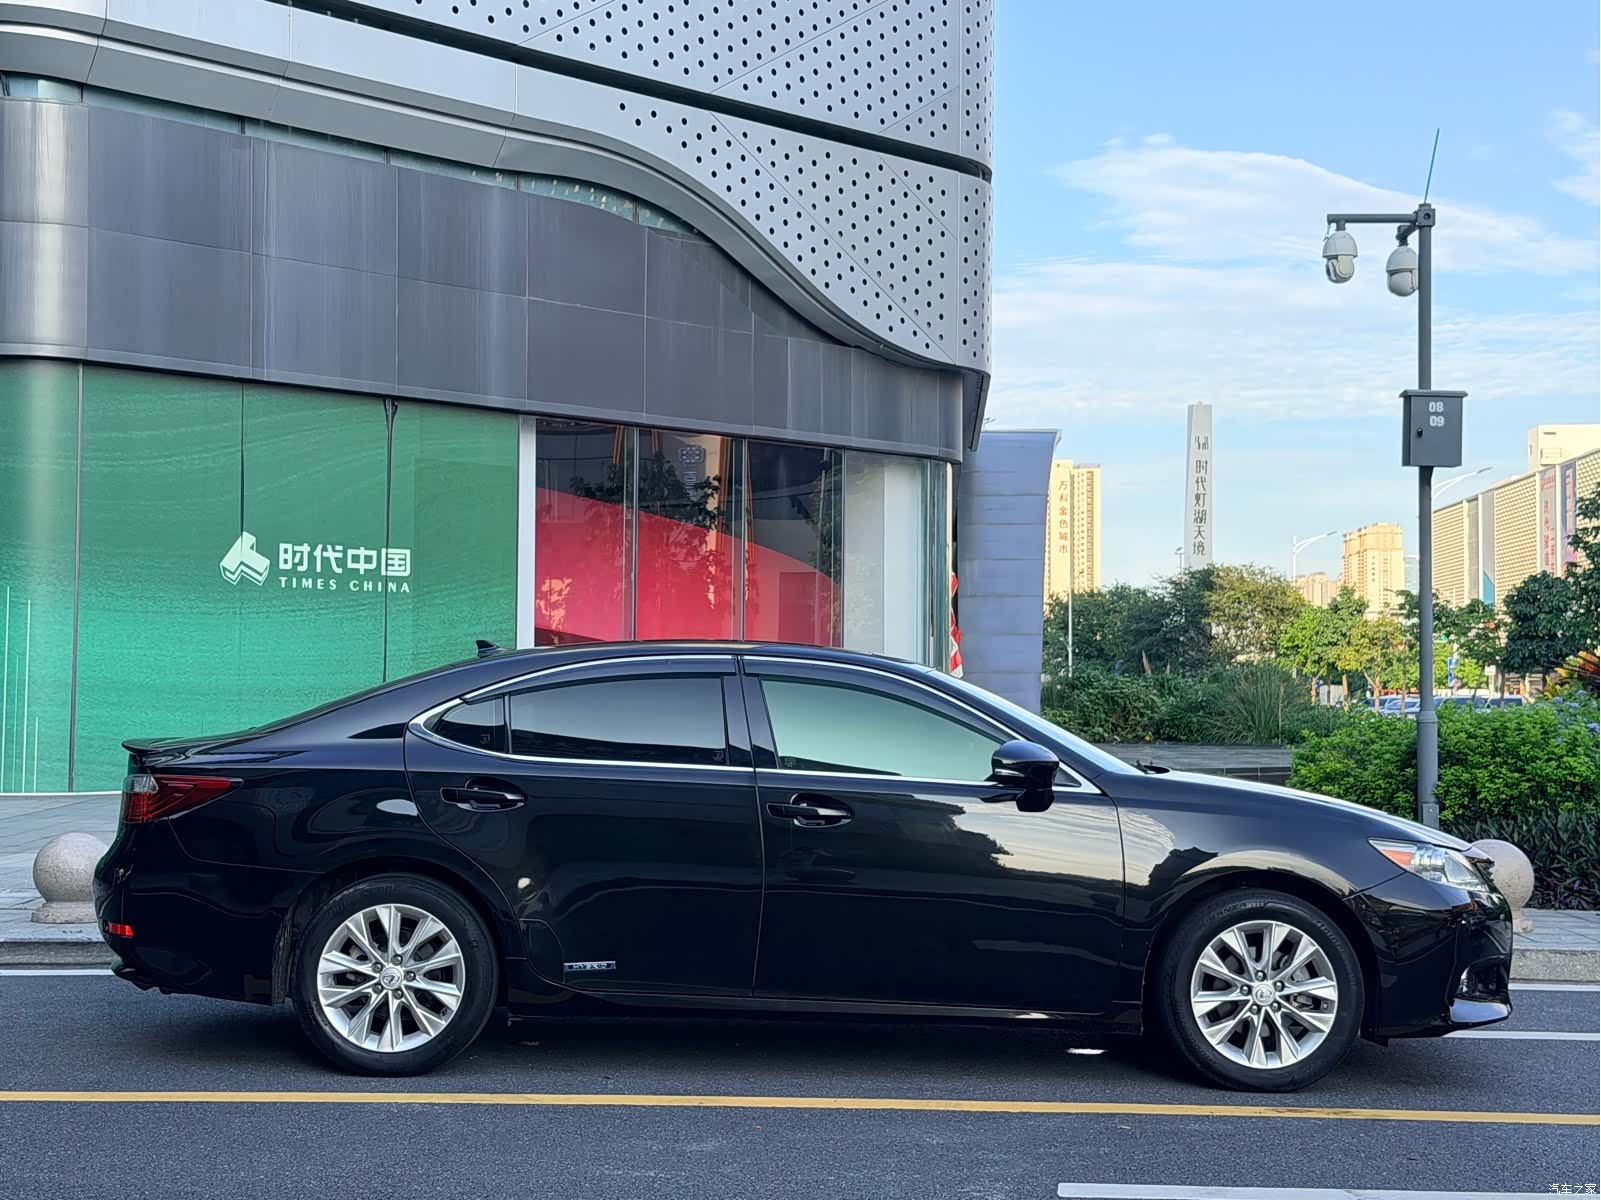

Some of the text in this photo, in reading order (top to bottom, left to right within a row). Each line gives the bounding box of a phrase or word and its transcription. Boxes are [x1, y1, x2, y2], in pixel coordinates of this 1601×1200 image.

[1428, 401, 1444, 413] 08
[1429, 415, 1445, 427] 09
[1058, 480, 1069, 554] 万科金色城市
[1193, 459, 1209, 556] 时代灯湖天境
[278, 542, 411, 577] 时代中国
[279, 576, 410, 593] TIMES CHINA
